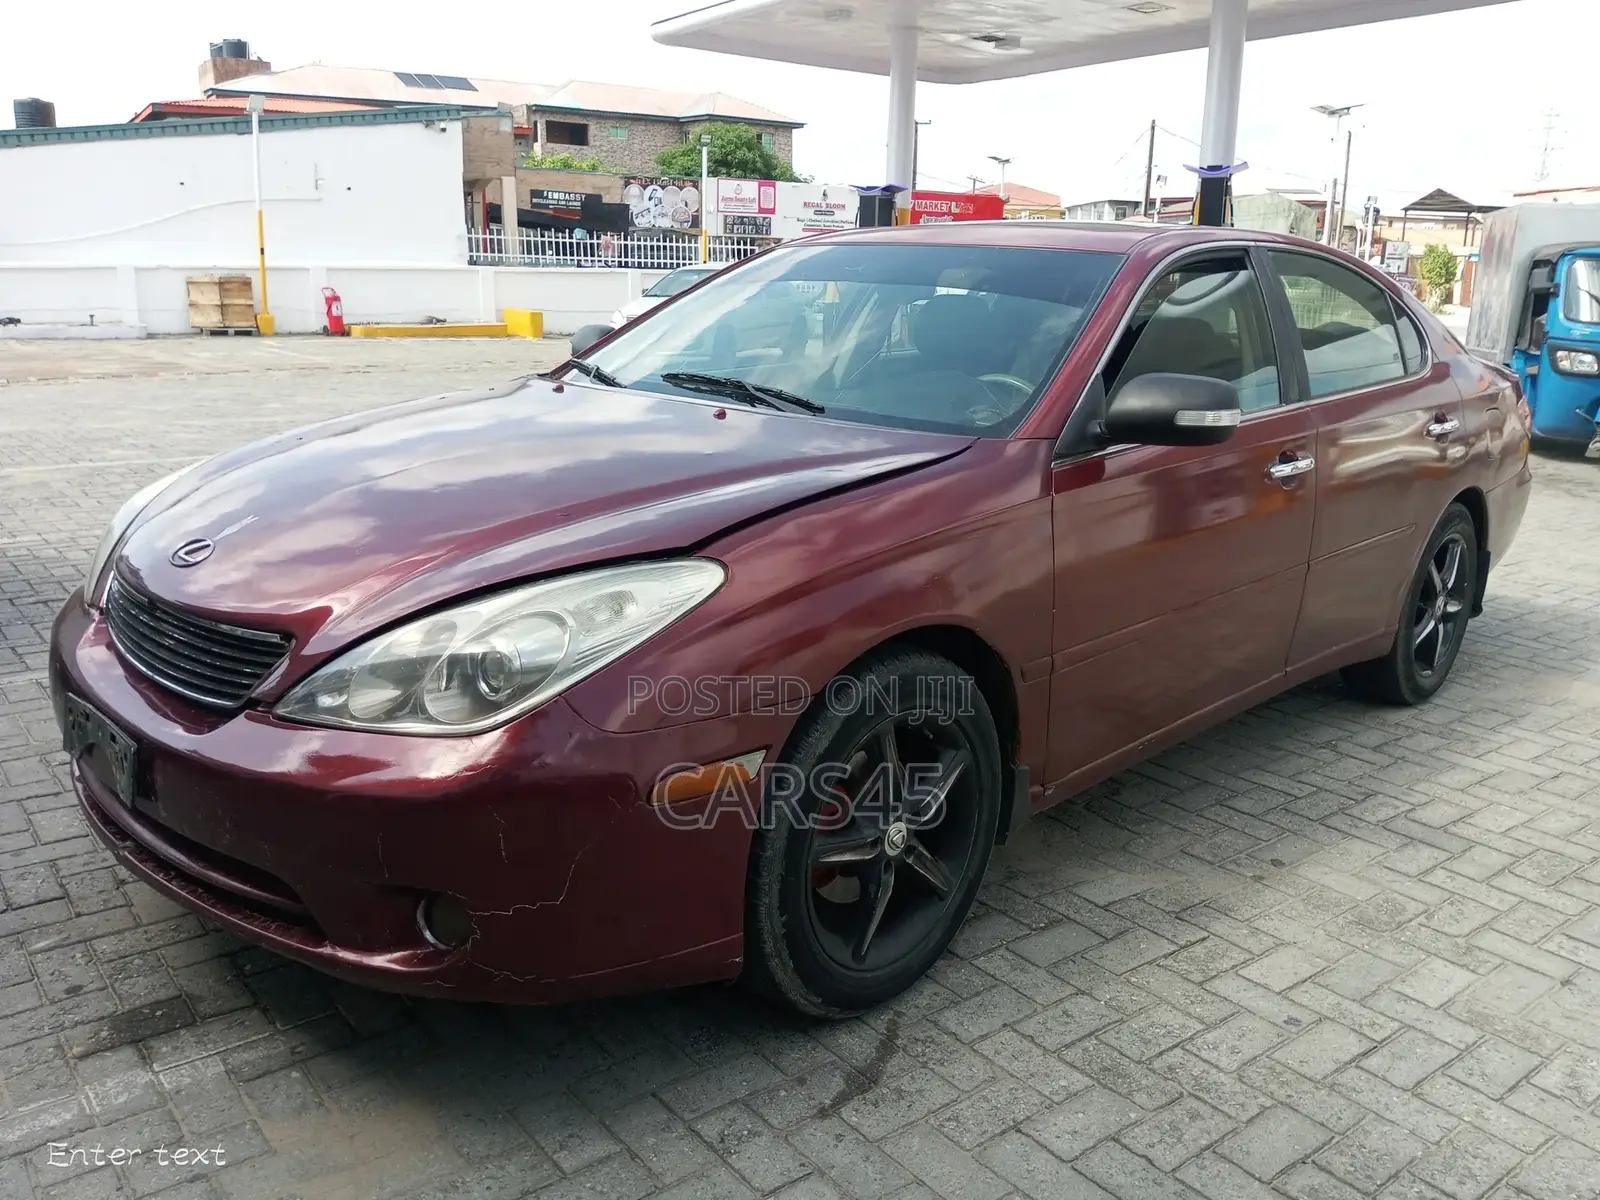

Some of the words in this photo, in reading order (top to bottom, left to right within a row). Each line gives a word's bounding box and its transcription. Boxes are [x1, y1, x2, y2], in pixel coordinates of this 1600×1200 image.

[548, 191, 586, 201] EMBASSY
[803, 201, 823, 209] REGAL
[825, 202, 846, 210] BLOOM
[915, 199, 951, 212] MARKET
